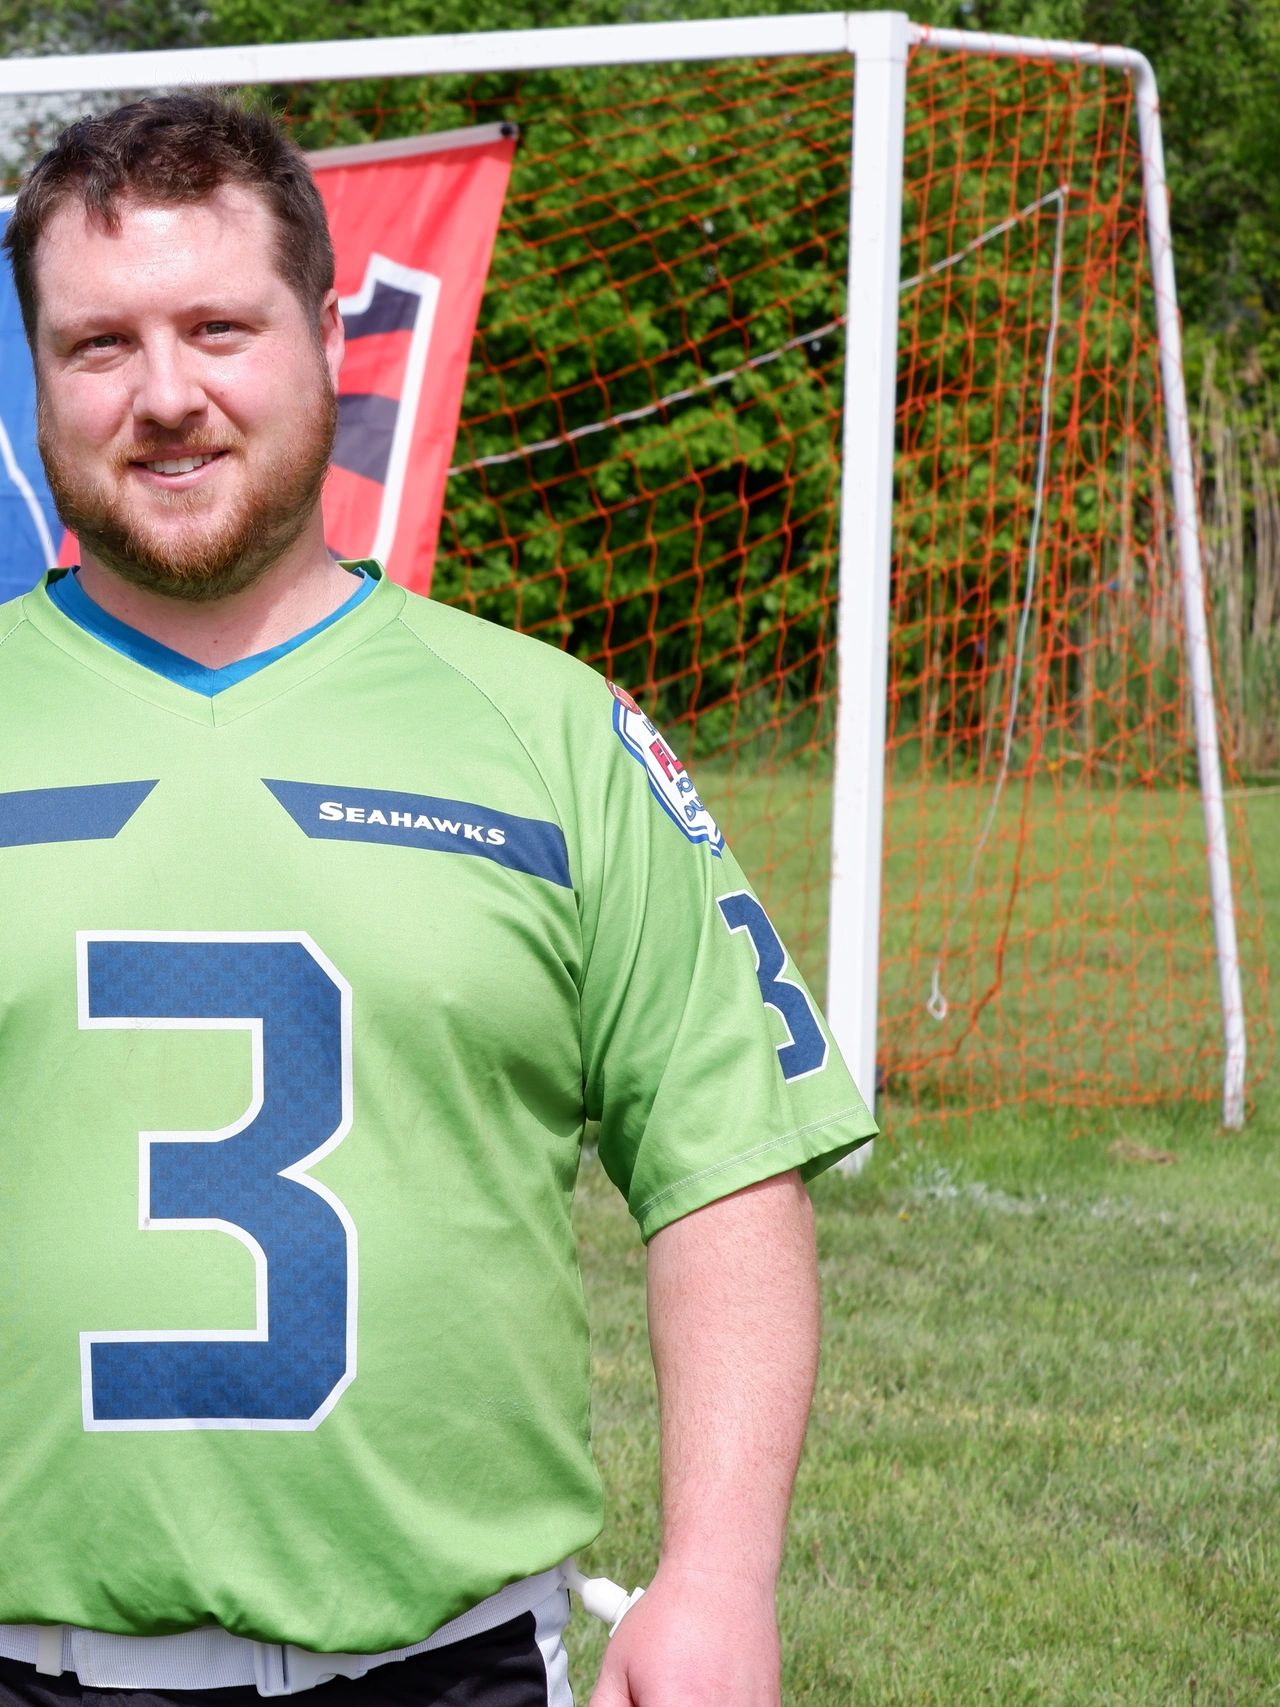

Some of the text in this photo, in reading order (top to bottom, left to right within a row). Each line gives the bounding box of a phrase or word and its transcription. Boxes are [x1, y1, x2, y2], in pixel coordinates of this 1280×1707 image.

[318, 801, 507, 846] SEAHAWKS
[715, 889, 829, 1084] 3
[76, 930, 357, 1431] 3
